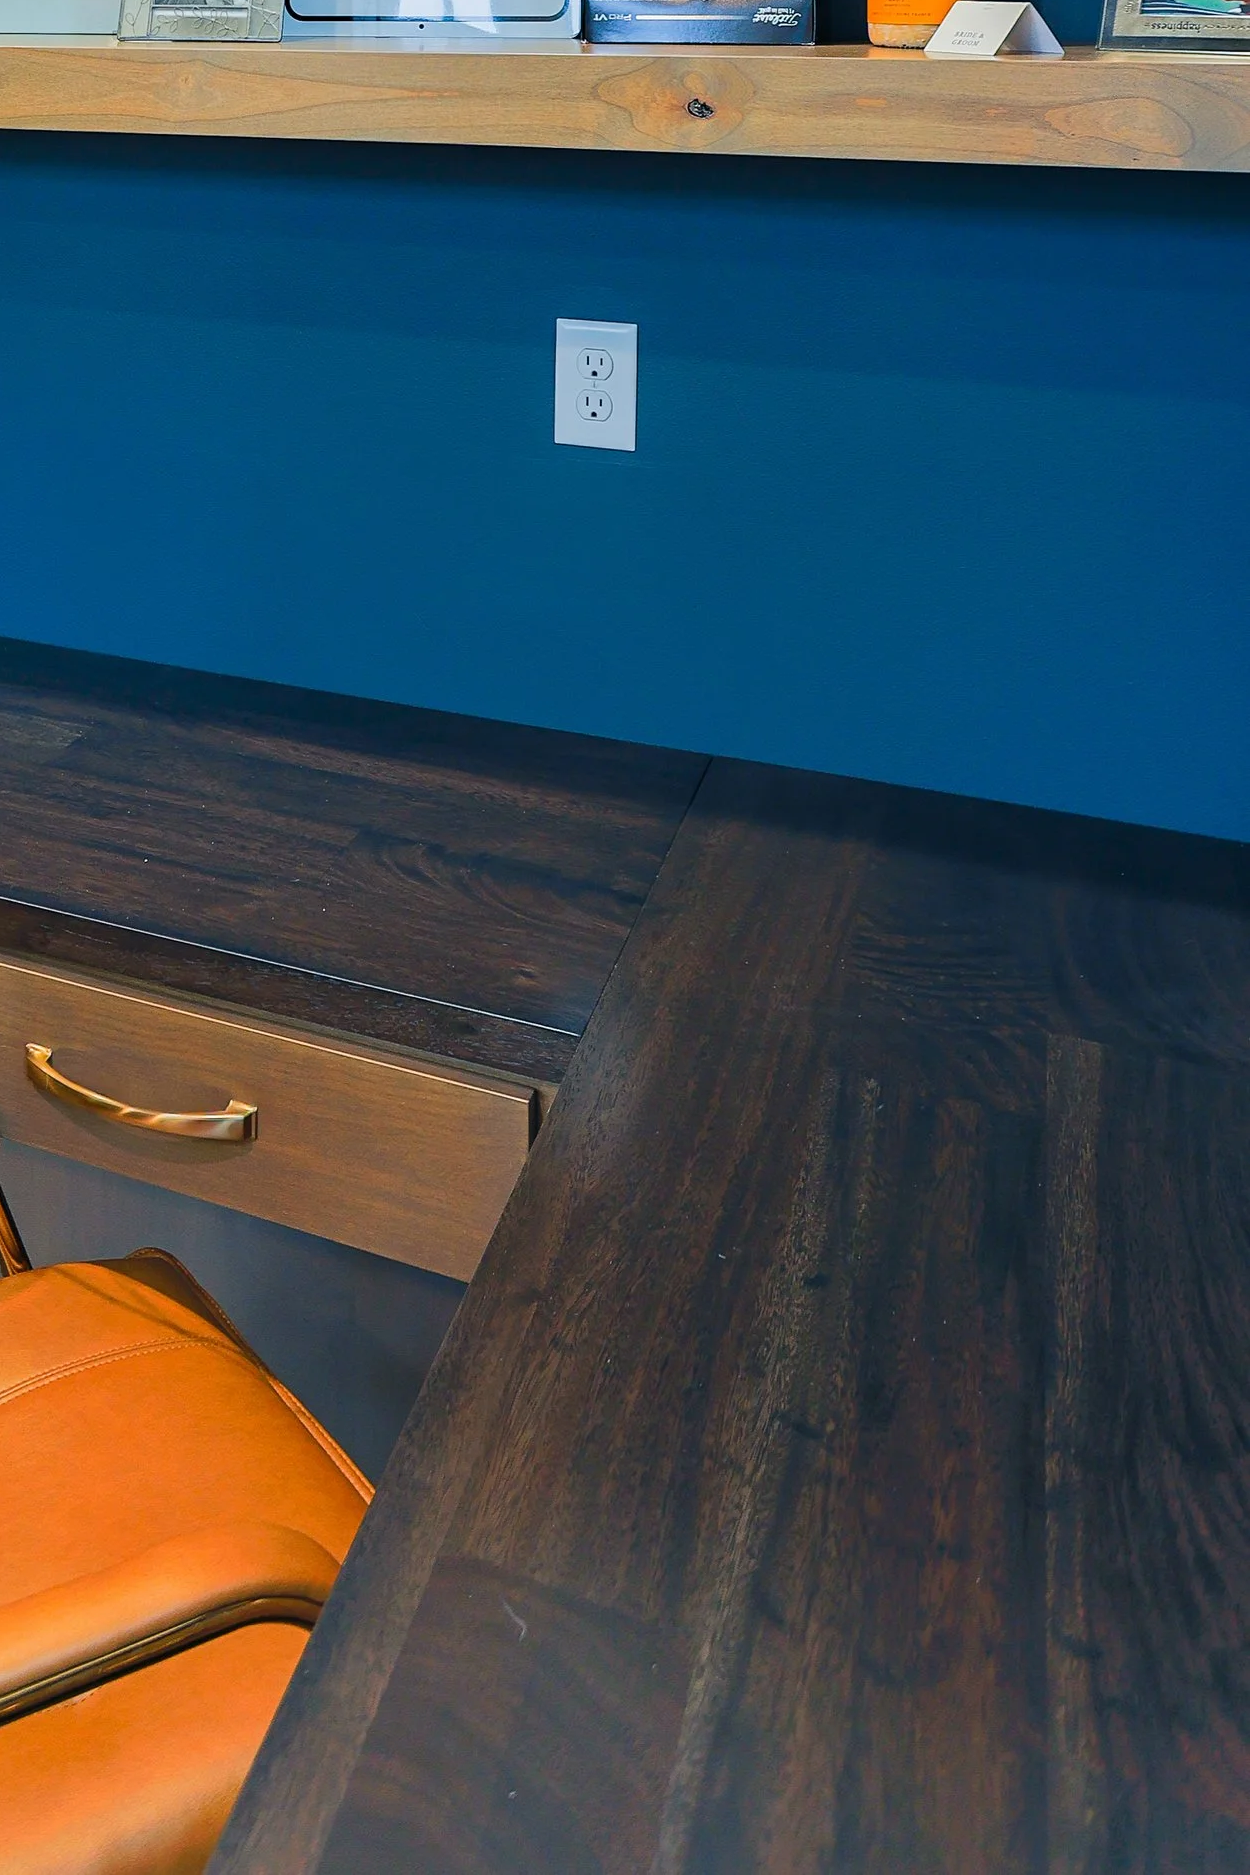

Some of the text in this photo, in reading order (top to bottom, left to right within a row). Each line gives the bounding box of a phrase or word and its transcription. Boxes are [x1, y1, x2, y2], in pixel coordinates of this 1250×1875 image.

[752, 12, 802, 27] Titleist
[1150, 21, 1202, 34] happiness
[953, 31, 978, 39] BRIDE
